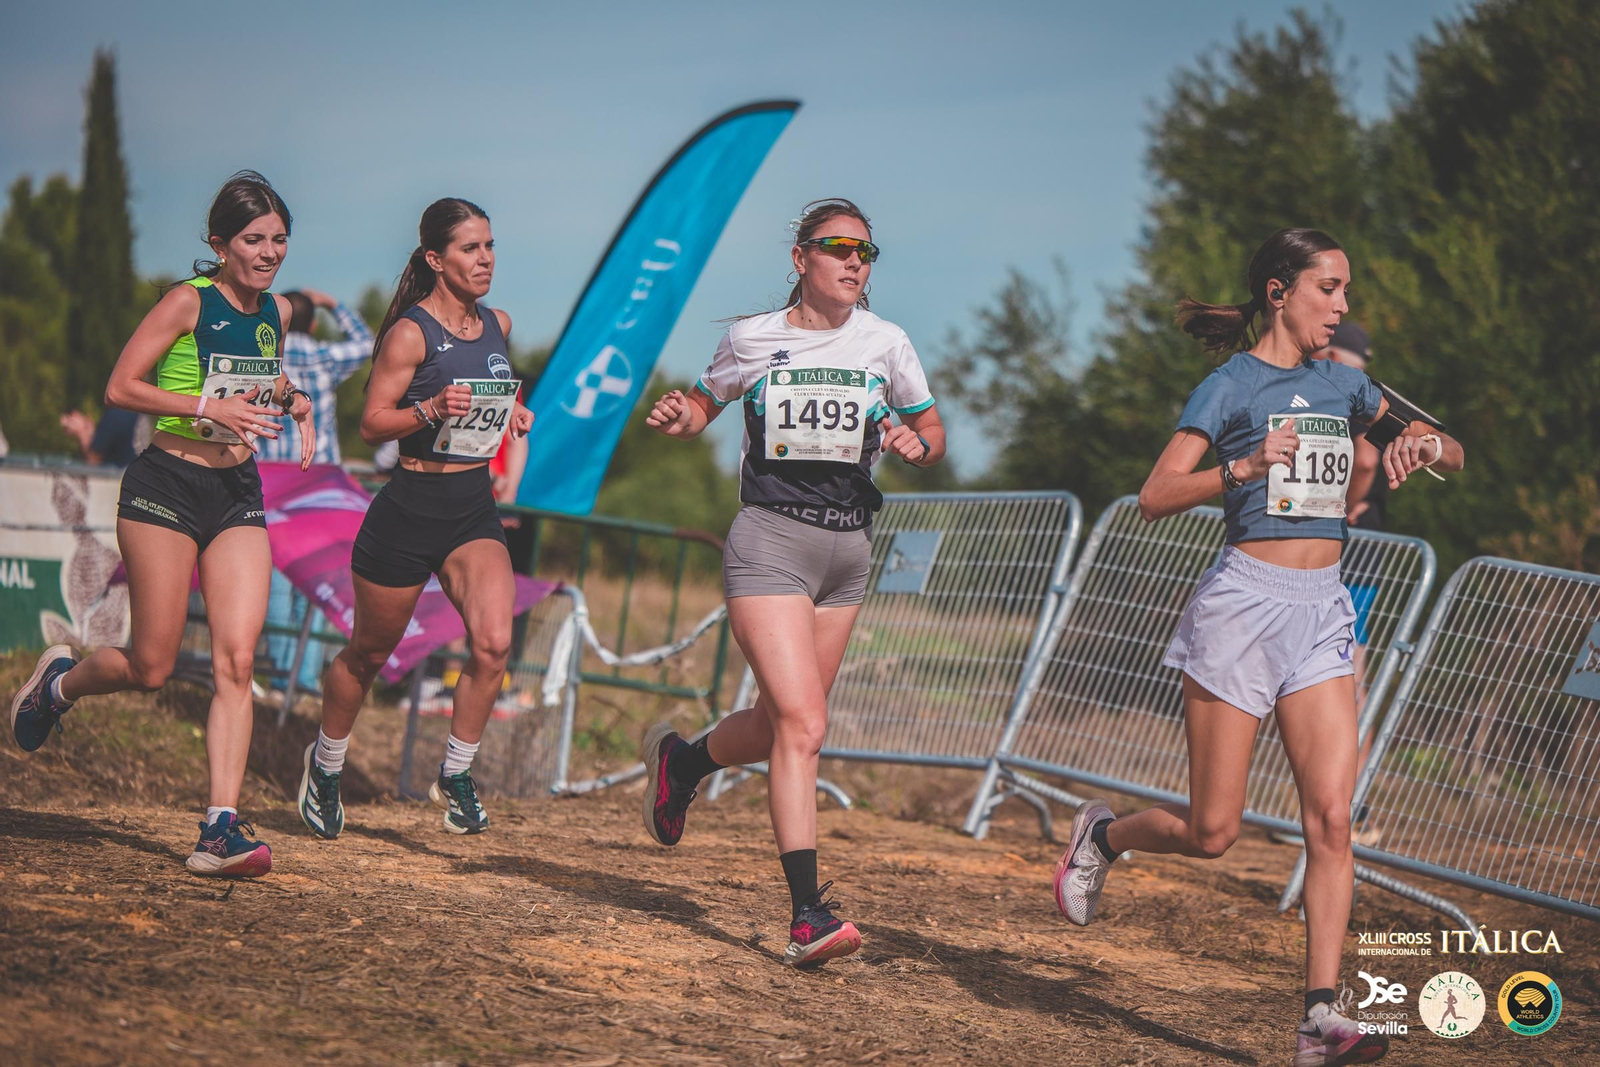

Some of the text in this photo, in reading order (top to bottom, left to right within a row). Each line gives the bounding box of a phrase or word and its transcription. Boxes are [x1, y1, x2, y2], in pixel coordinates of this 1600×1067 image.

[236, 360, 270, 373] ITÁLICA
[798, 369, 844, 382] ITÁLICA
[476, 382, 505, 394] ITÁLICA
[778, 399, 860, 432] 1493
[1302, 418, 1338, 433] ITÁLICA
[1283, 452, 1349, 486] 1189
[154, 509, 179, 523] GRANADA
[824, 506, 864, 527] PRO
